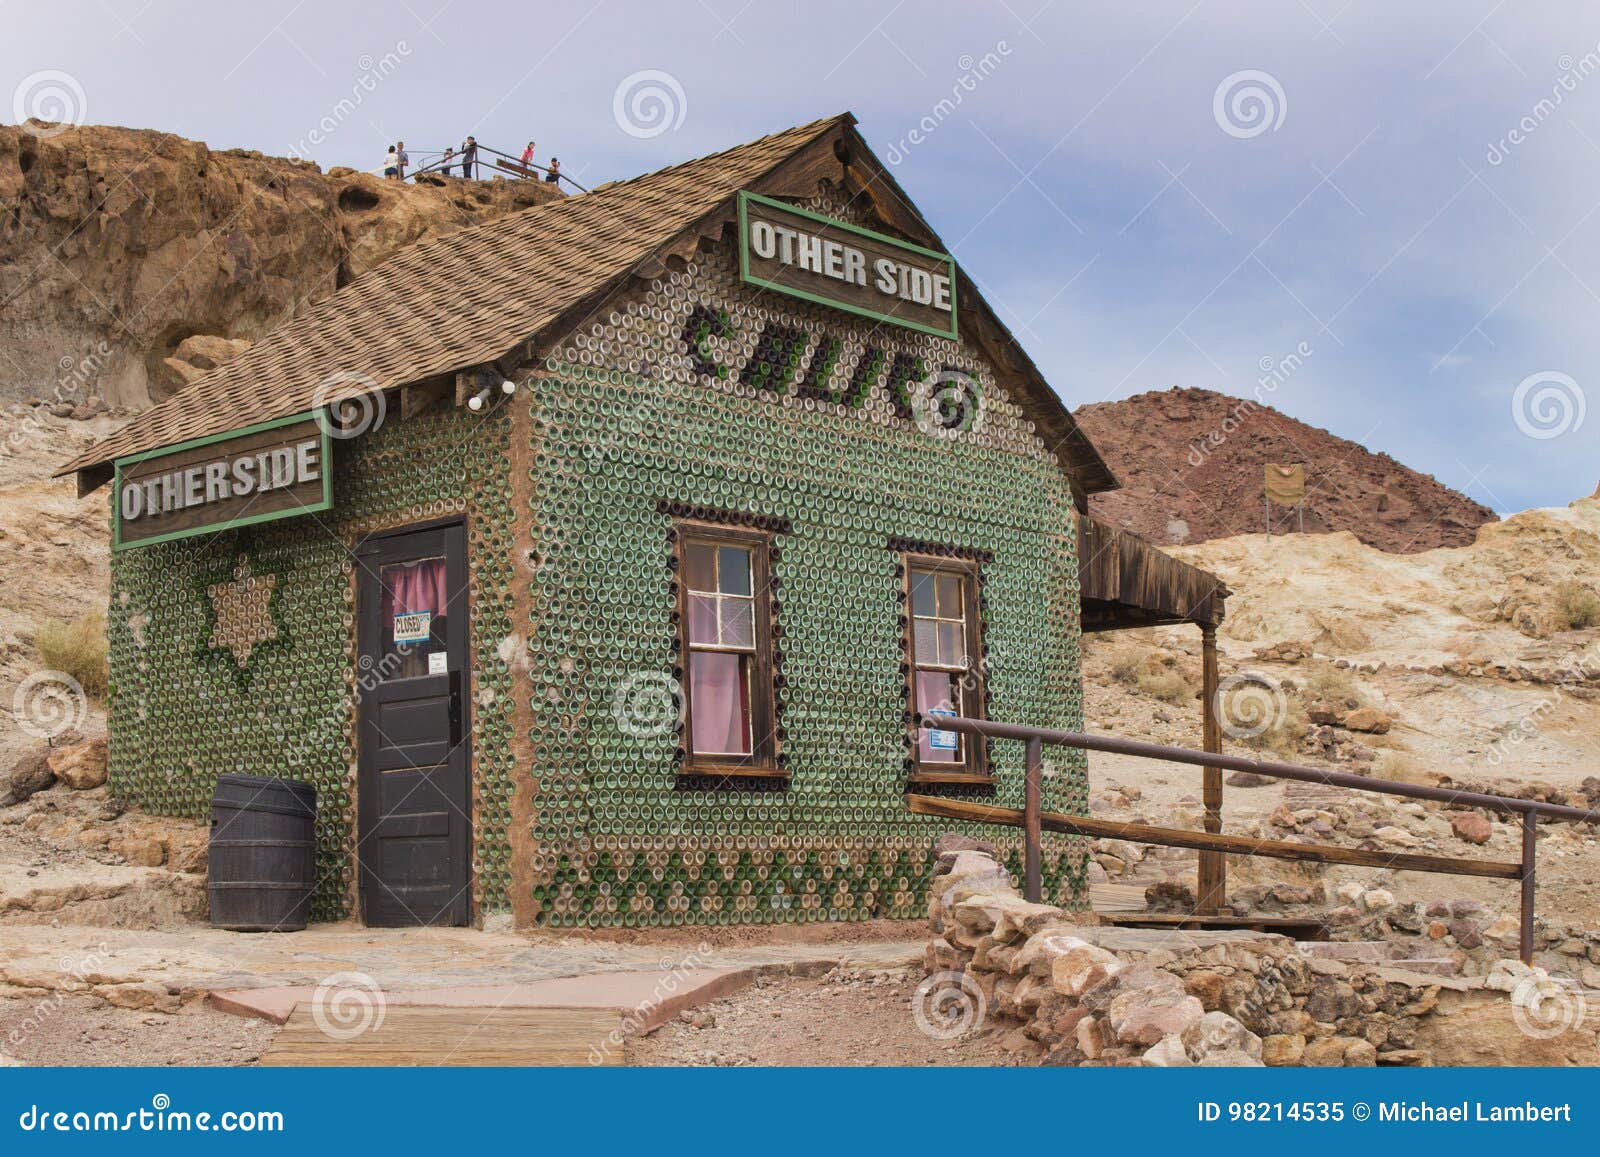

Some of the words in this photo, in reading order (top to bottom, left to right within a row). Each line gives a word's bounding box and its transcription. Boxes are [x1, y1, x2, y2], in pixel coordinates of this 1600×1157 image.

[752, 220, 867, 287] OTHER
[873, 258, 952, 312] SIDE
[395, 615, 421, 634] CLOSED
